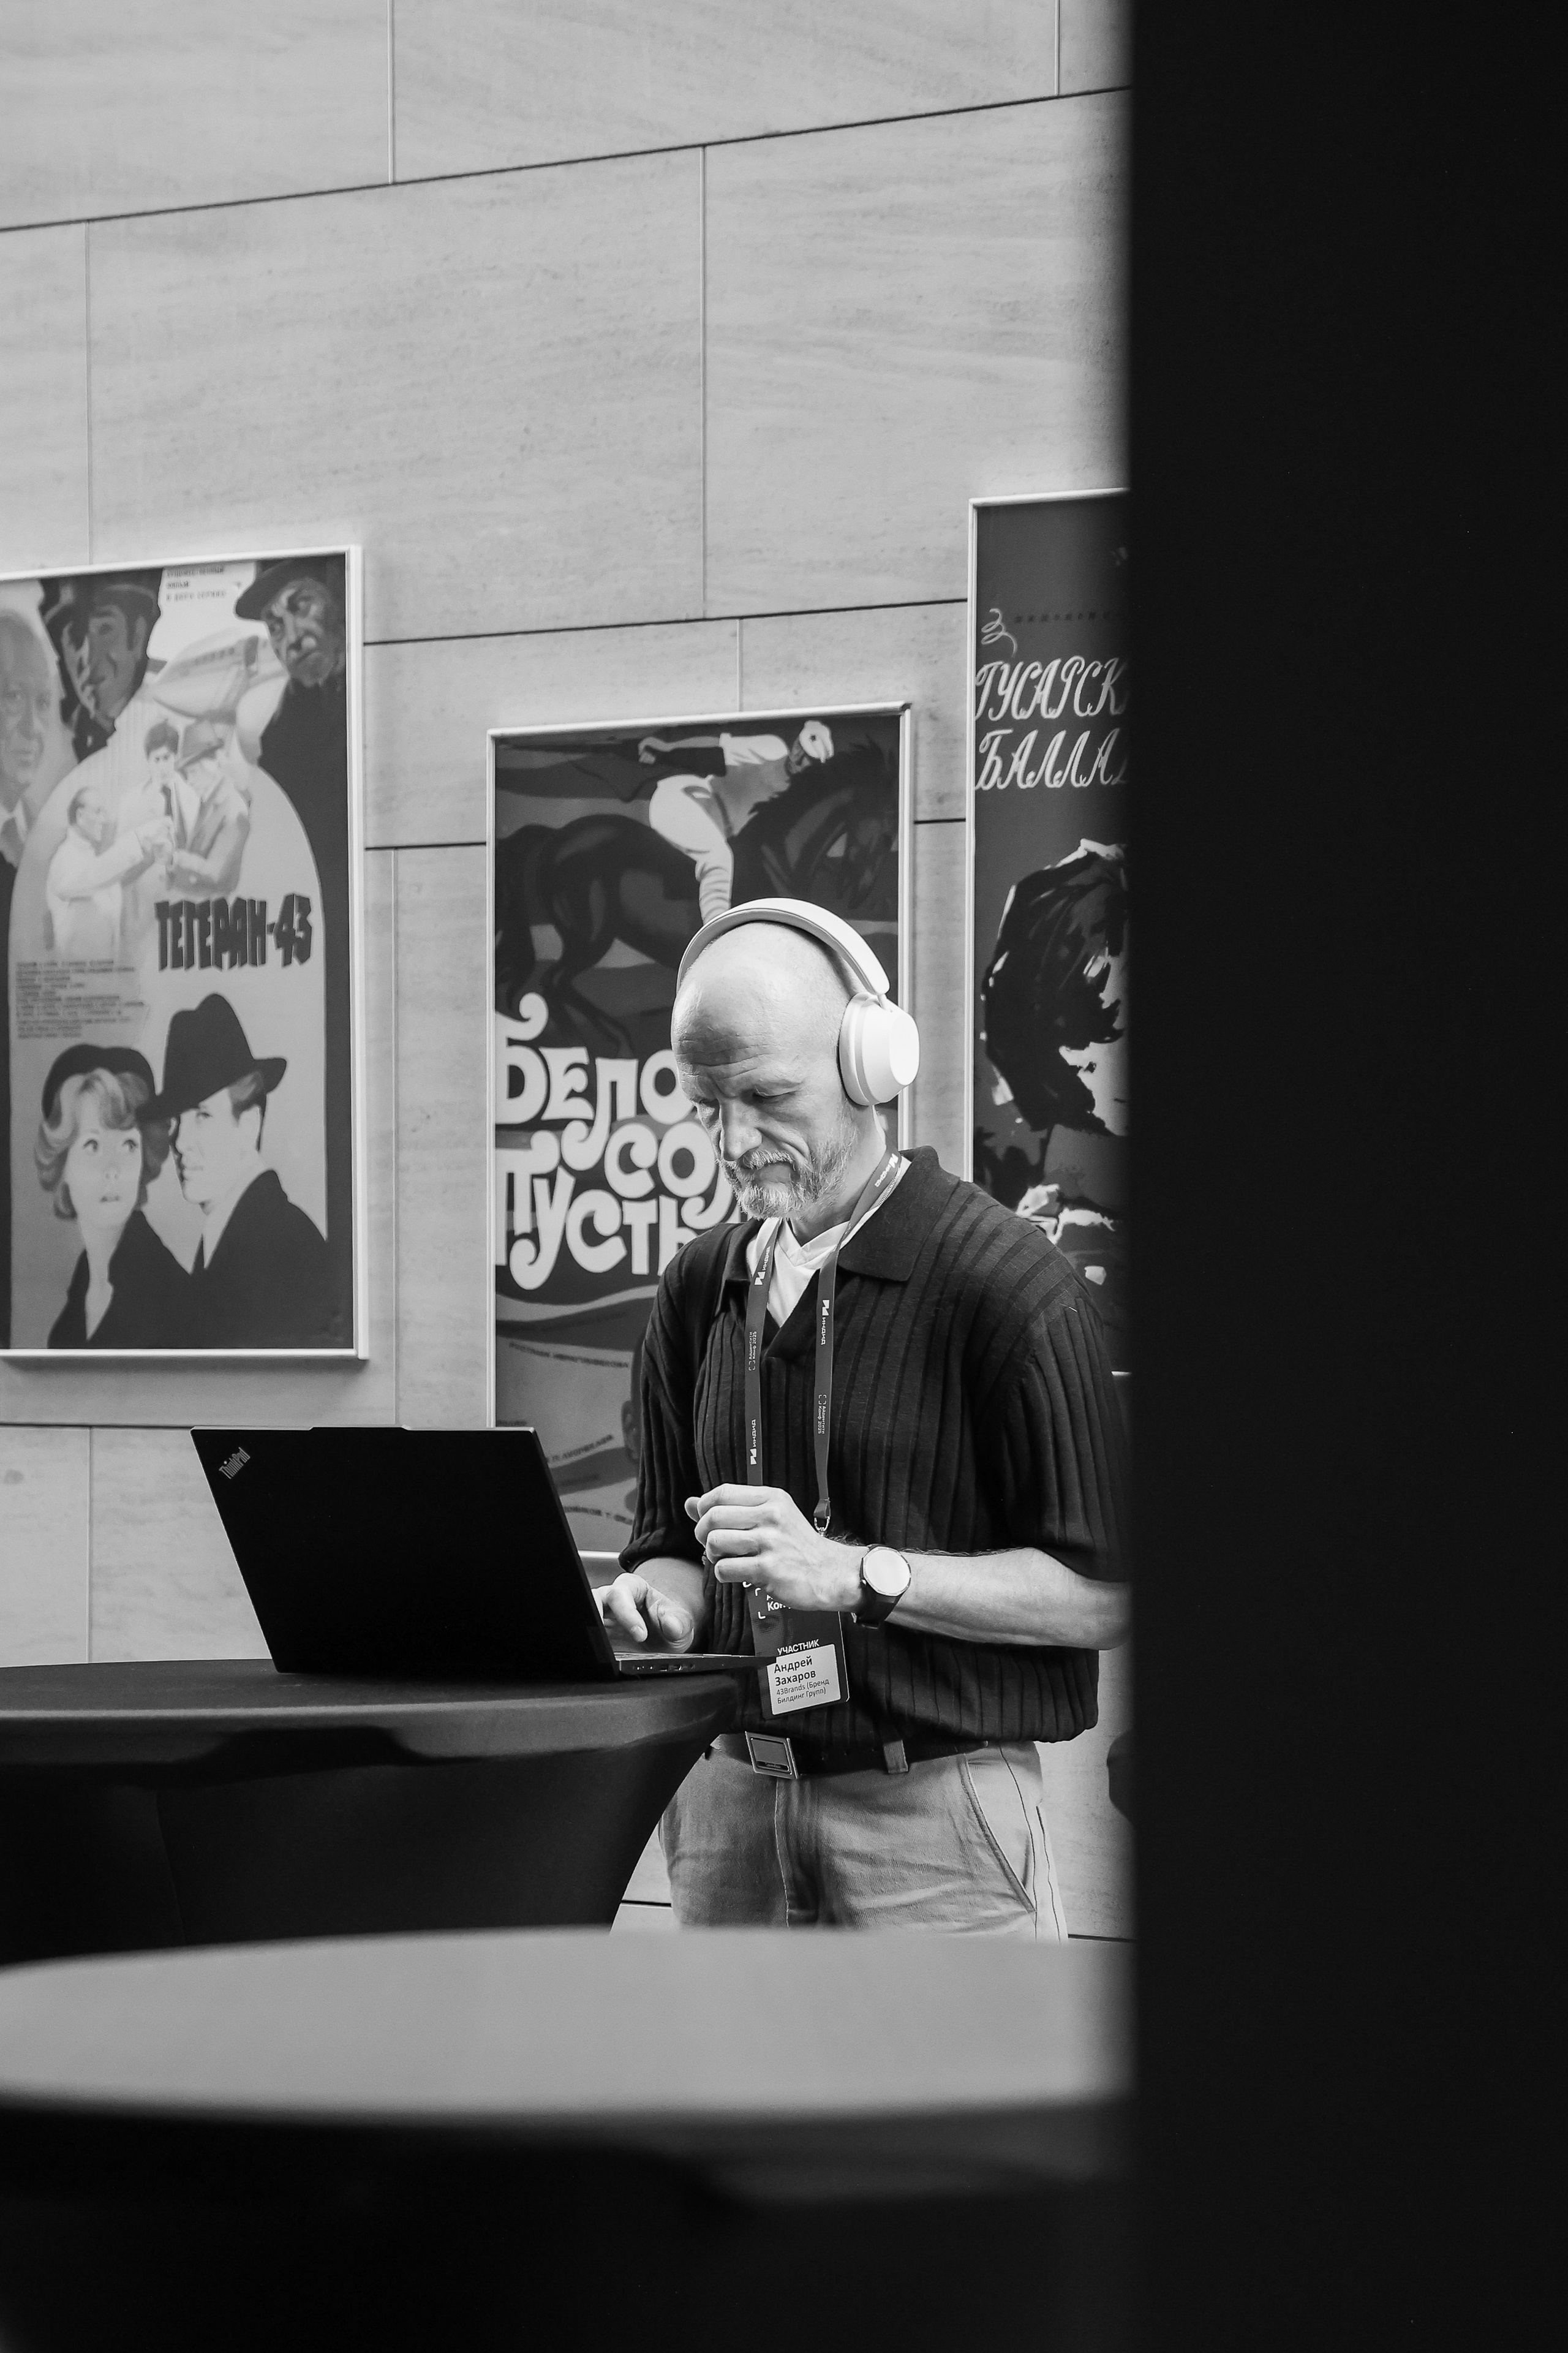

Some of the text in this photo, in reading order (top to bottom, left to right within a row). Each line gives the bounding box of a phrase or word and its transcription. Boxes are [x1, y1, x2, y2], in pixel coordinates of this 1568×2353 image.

[974, 728, 1127, 790] БАЛЛА
[154, 893, 312, 972] ТЕГЕРАН-43
[219, 1447, 251, 1479] ThinkPad
[777, 1639, 820, 1655] УЧАСТНИК
[774, 1655, 812, 1674] Андрей
[775, 1671, 816, 1686] Захаров
[776, 1679, 830, 1696] 43Brands (Бренд
[777, 1686, 826, 1704] Билдинг Групп)
